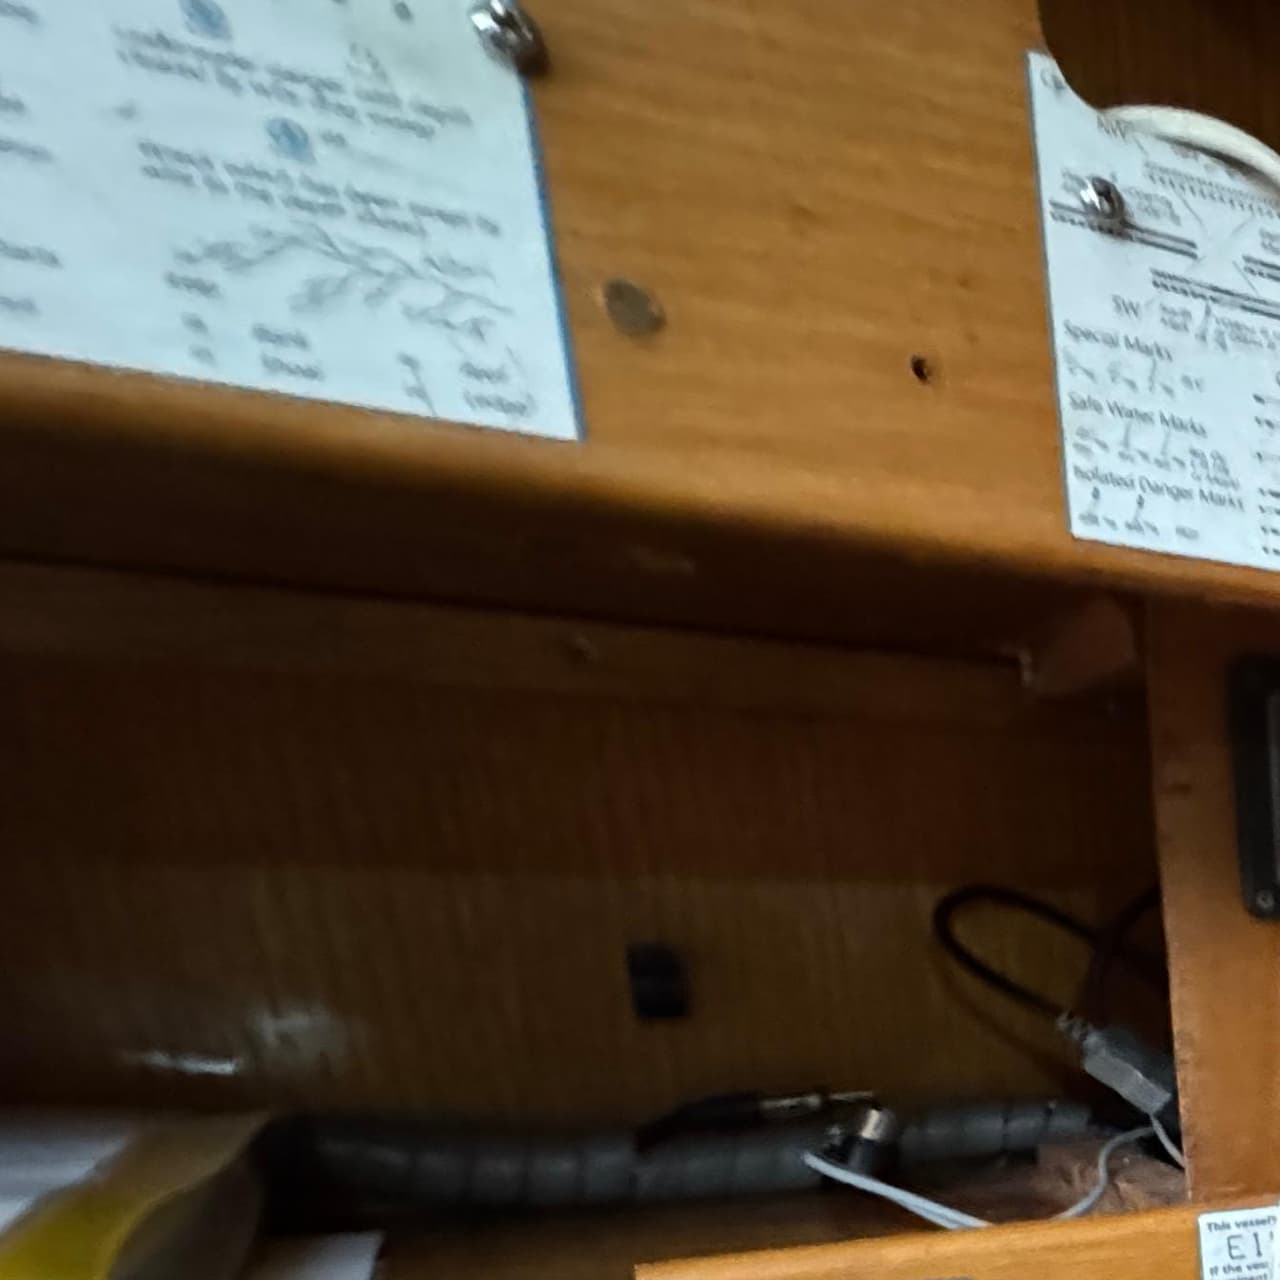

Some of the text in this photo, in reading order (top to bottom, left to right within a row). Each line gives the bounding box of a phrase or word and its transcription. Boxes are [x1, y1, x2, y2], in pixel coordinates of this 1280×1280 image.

[1123, 333, 1173, 362] Marks
[1106, 399, 1155, 426] Water
[1207, 1221, 1233, 1233] This
[1222, 1262, 1244, 1274] the
